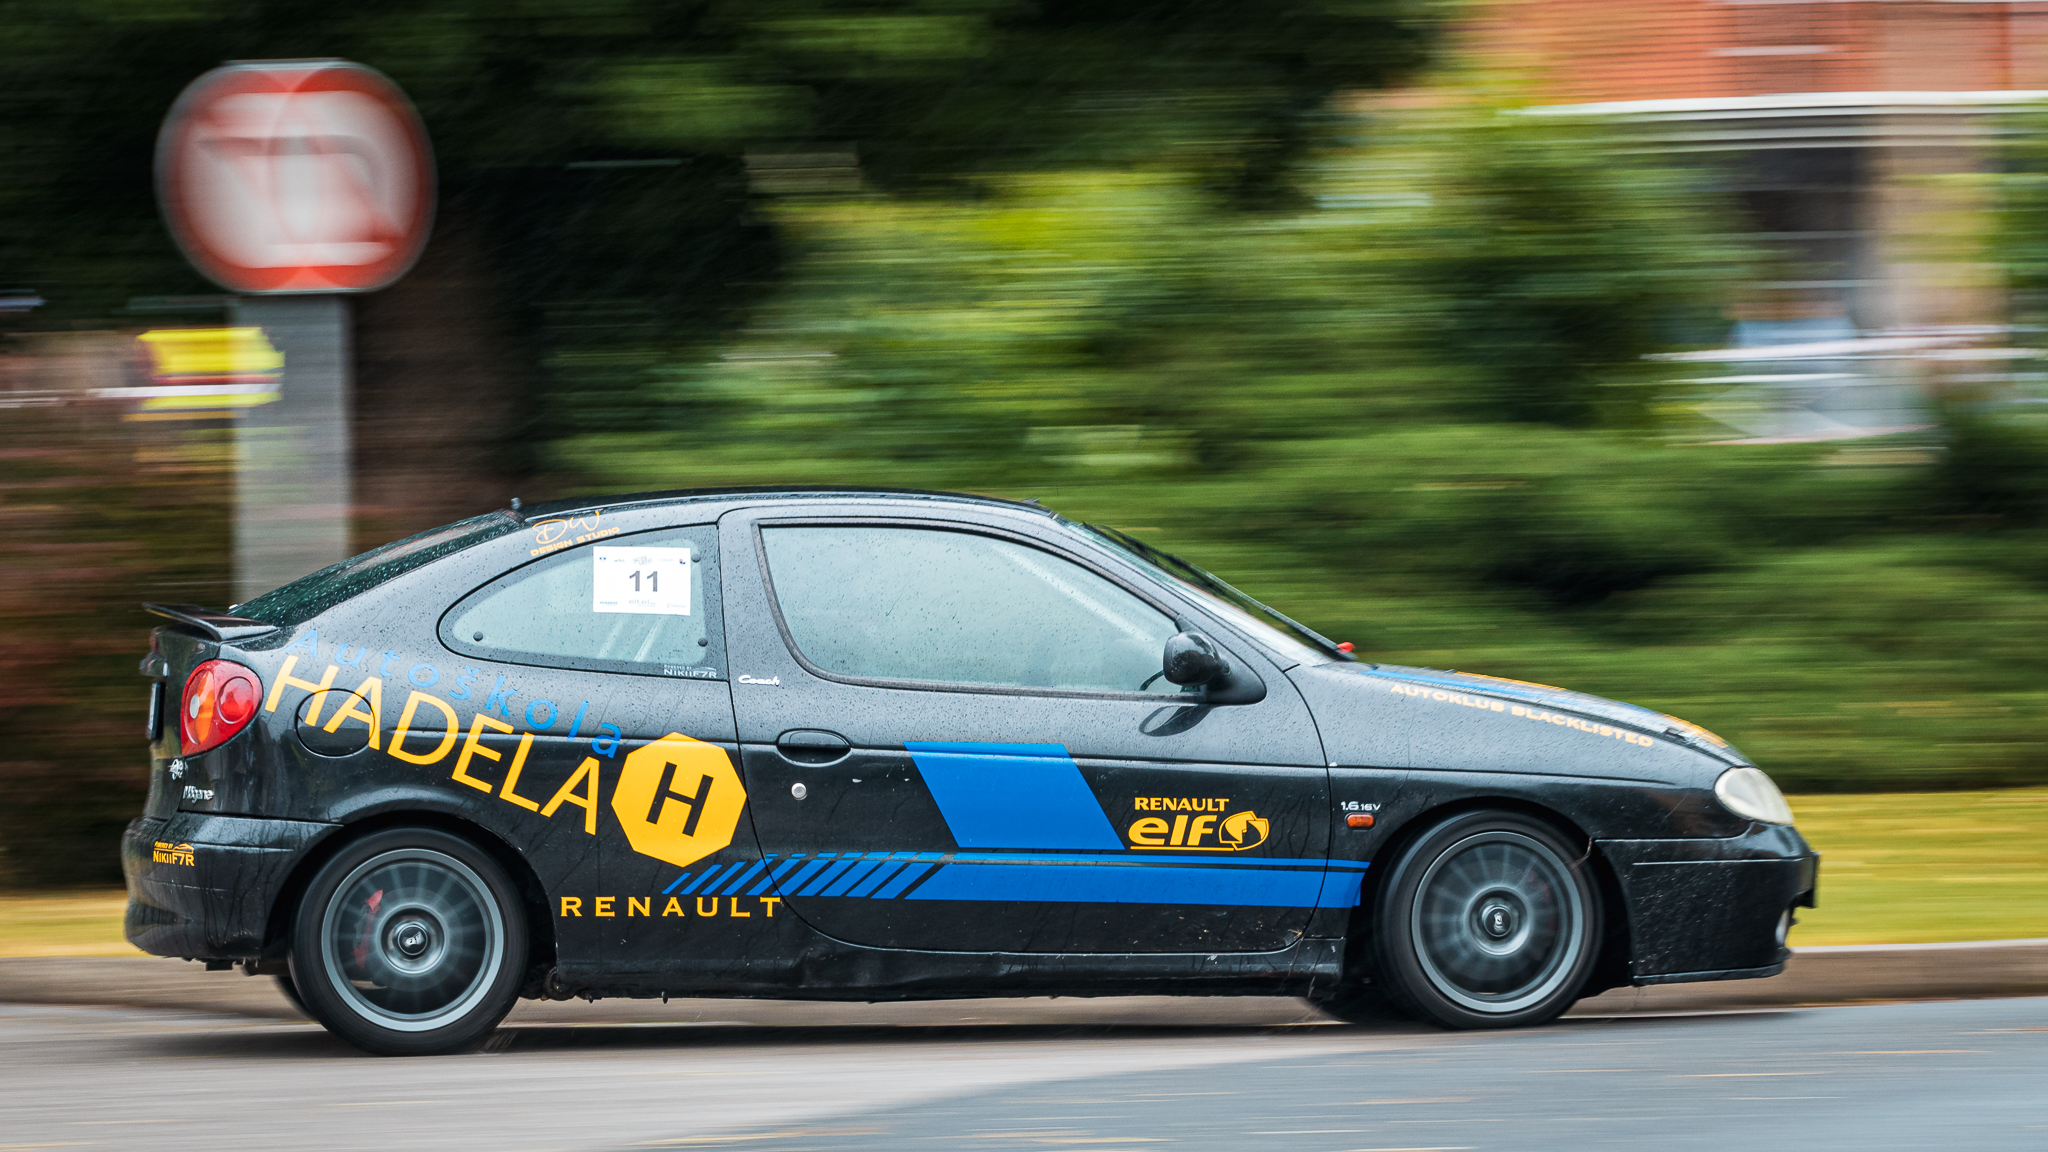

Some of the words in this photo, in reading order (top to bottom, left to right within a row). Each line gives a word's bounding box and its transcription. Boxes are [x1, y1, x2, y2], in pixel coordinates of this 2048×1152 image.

[530, 539, 573, 557] DESIGN
[576, 526, 620, 543] STUDIO
[629, 570, 658, 592] 11
[282, 628, 622, 759] Autoškola
[738, 674, 780, 685] Coach
[1390, 684, 1505, 713] AUTOKLUB
[1511, 704, 1654, 747] BLACKLISTED
[264, 655, 600, 836] HADELA
[646, 761, 714, 837] H
[1134, 797, 1230, 812] RENAULT
[1341, 801, 1360, 811] 1.6
[1361, 803, 1381, 811] 16V
[1128, 814, 1218, 846] elf
[560, 896, 781, 918] RENAULT
